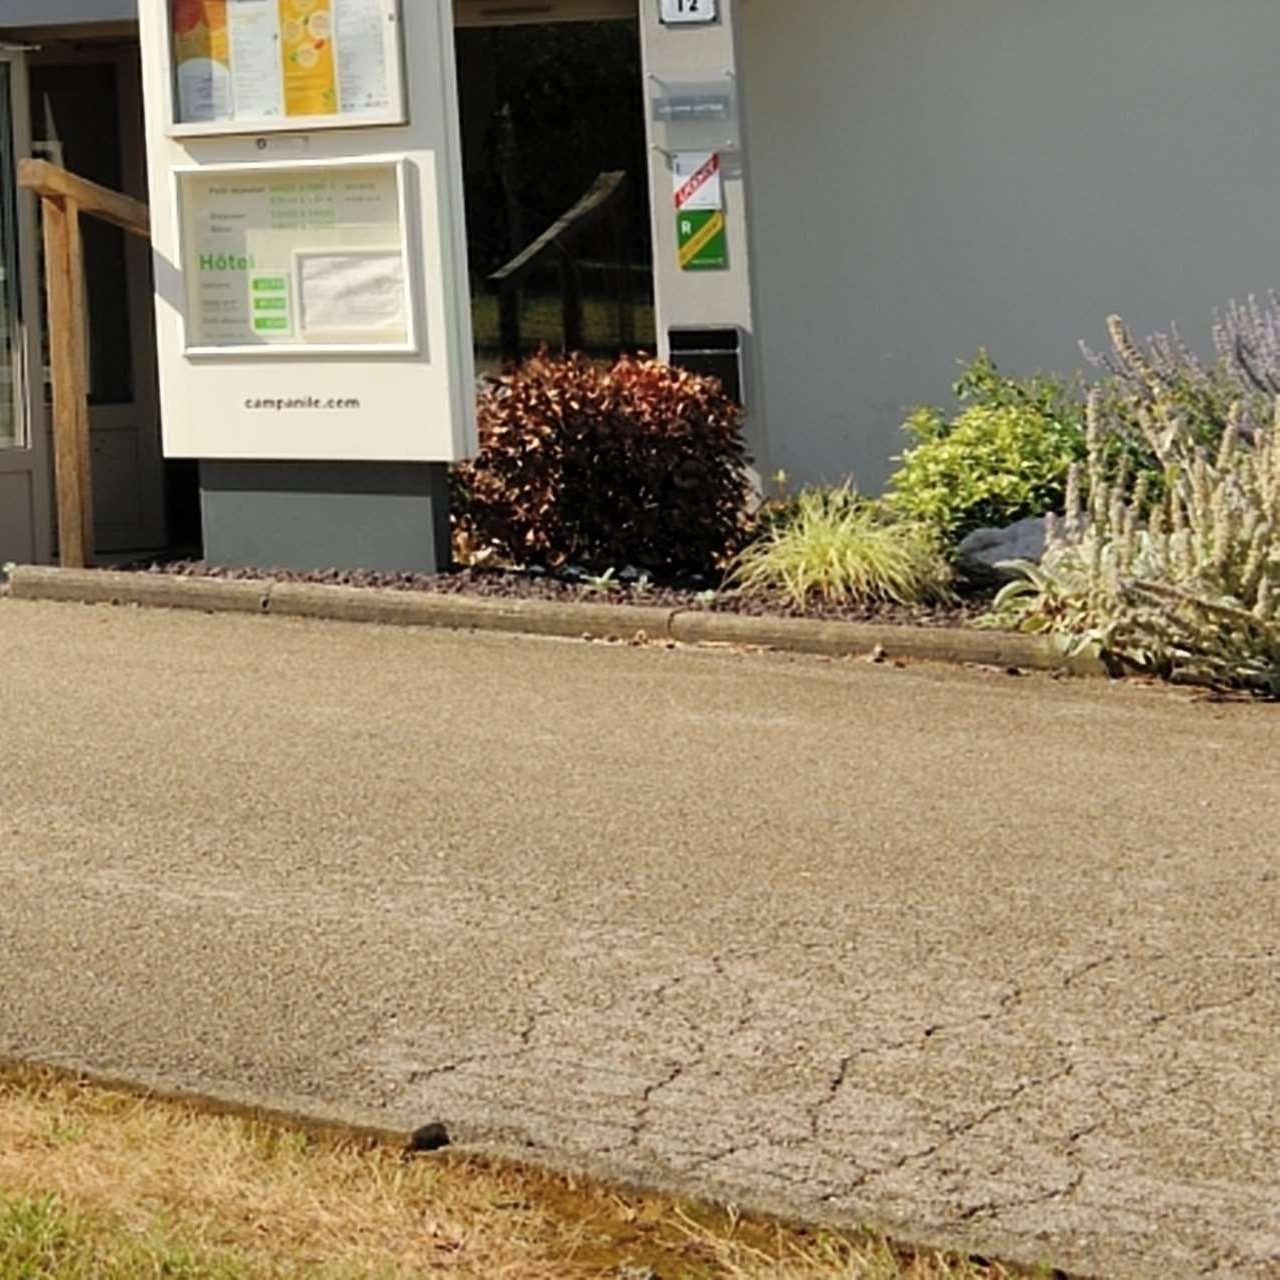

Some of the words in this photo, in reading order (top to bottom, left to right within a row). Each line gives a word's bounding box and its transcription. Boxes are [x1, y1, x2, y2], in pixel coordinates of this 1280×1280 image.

[681, 220, 692, 235] R
[199, 250, 255, 271] Hôtel
[244, 396, 361, 411] campanile.com
